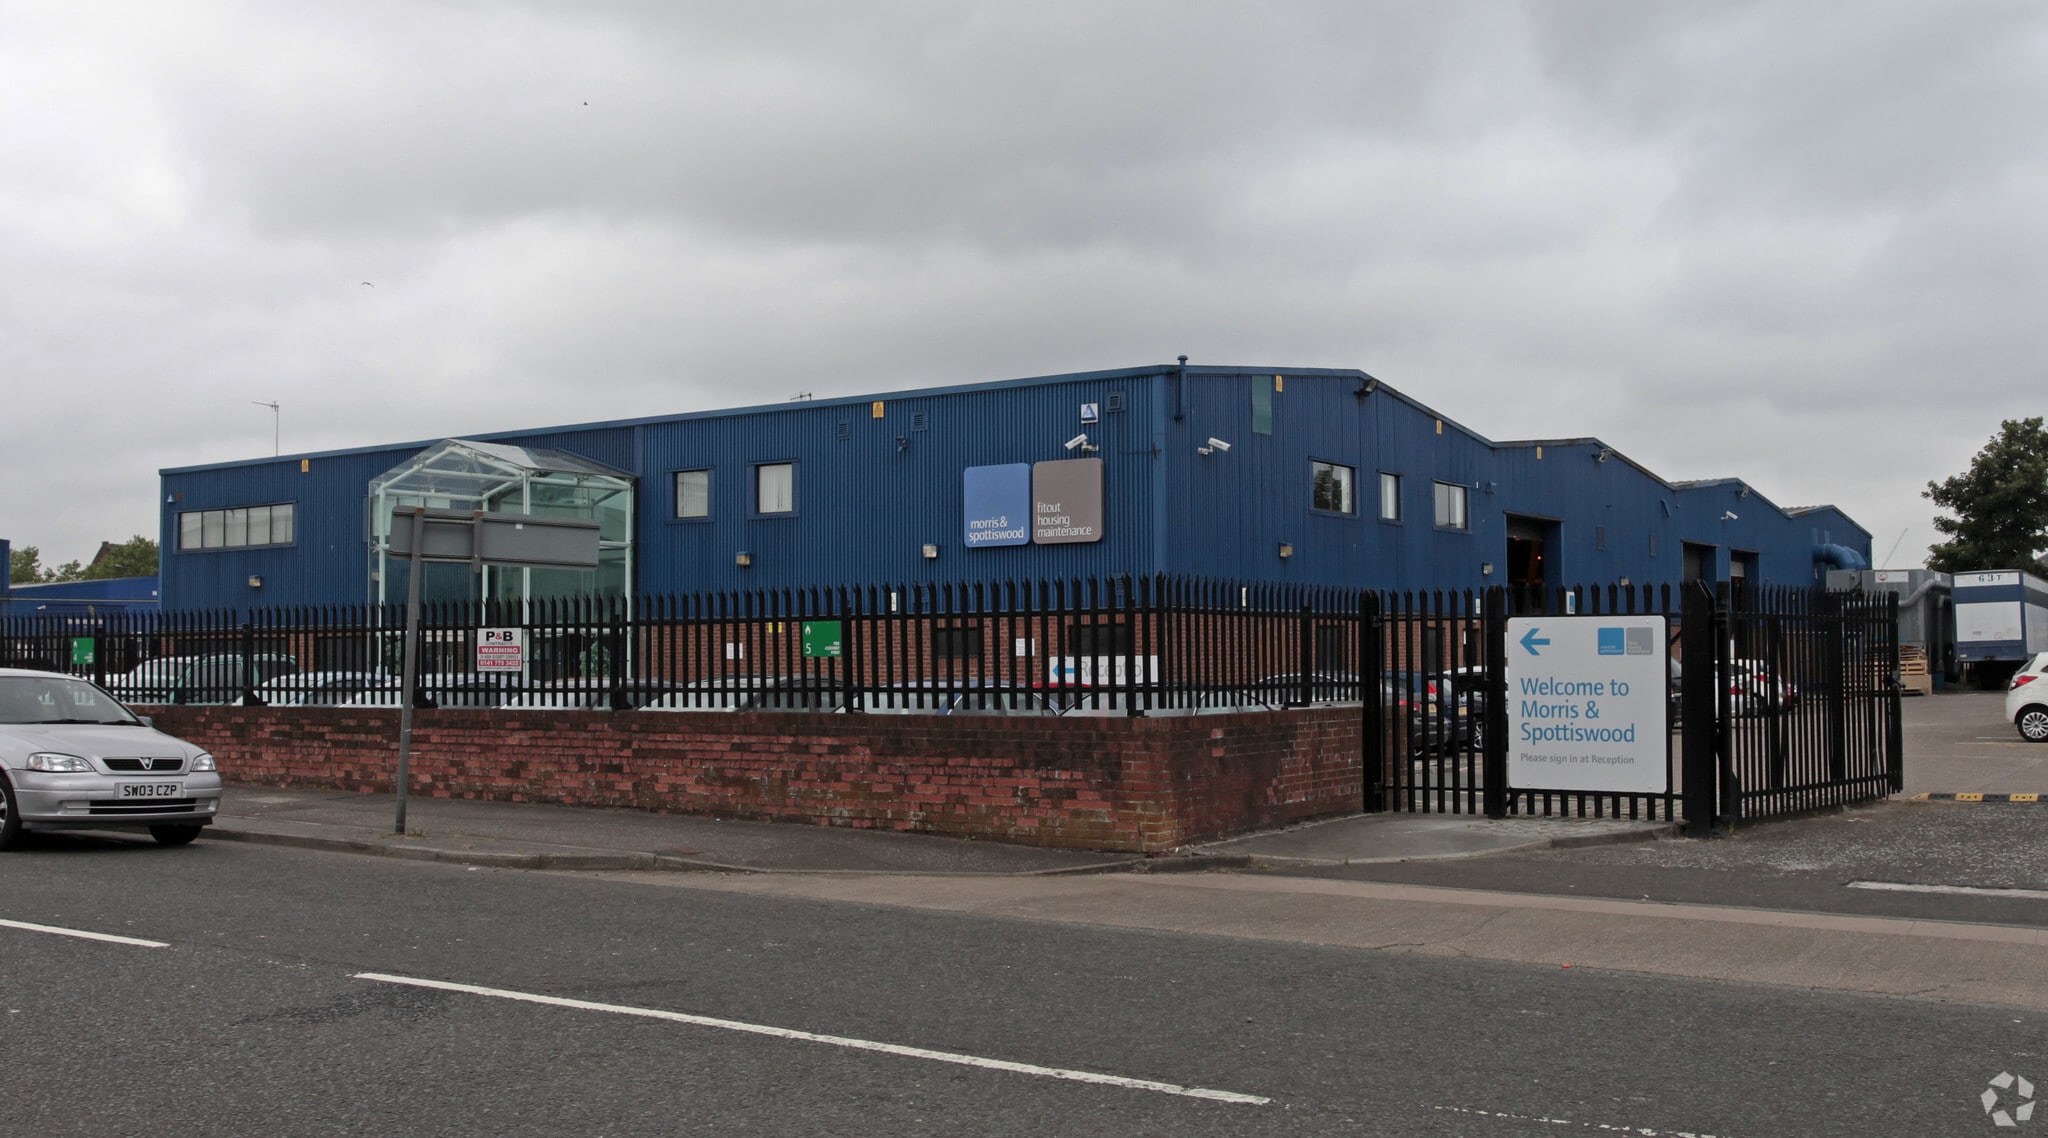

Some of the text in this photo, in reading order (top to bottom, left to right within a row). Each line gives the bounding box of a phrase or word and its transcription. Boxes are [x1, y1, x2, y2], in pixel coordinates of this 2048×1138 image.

[1037, 501, 1061, 513] fitout
[970, 516, 1008, 529] morris &
[1037, 514, 1070, 527] housing
[969, 526, 1024, 544] spottiswood
[1037, 526, 1092, 538] maintenance
[486, 631, 513, 641] P&B
[805, 643, 811, 654] 5
[1520, 677, 1629, 696] Welcome to
[1521, 699, 1600, 719] Morris &
[1521, 722, 1635, 746] Spottiswood
[1520, 753, 1635, 765] Please sign in at Reception
[157, 785, 177, 796] CZP
